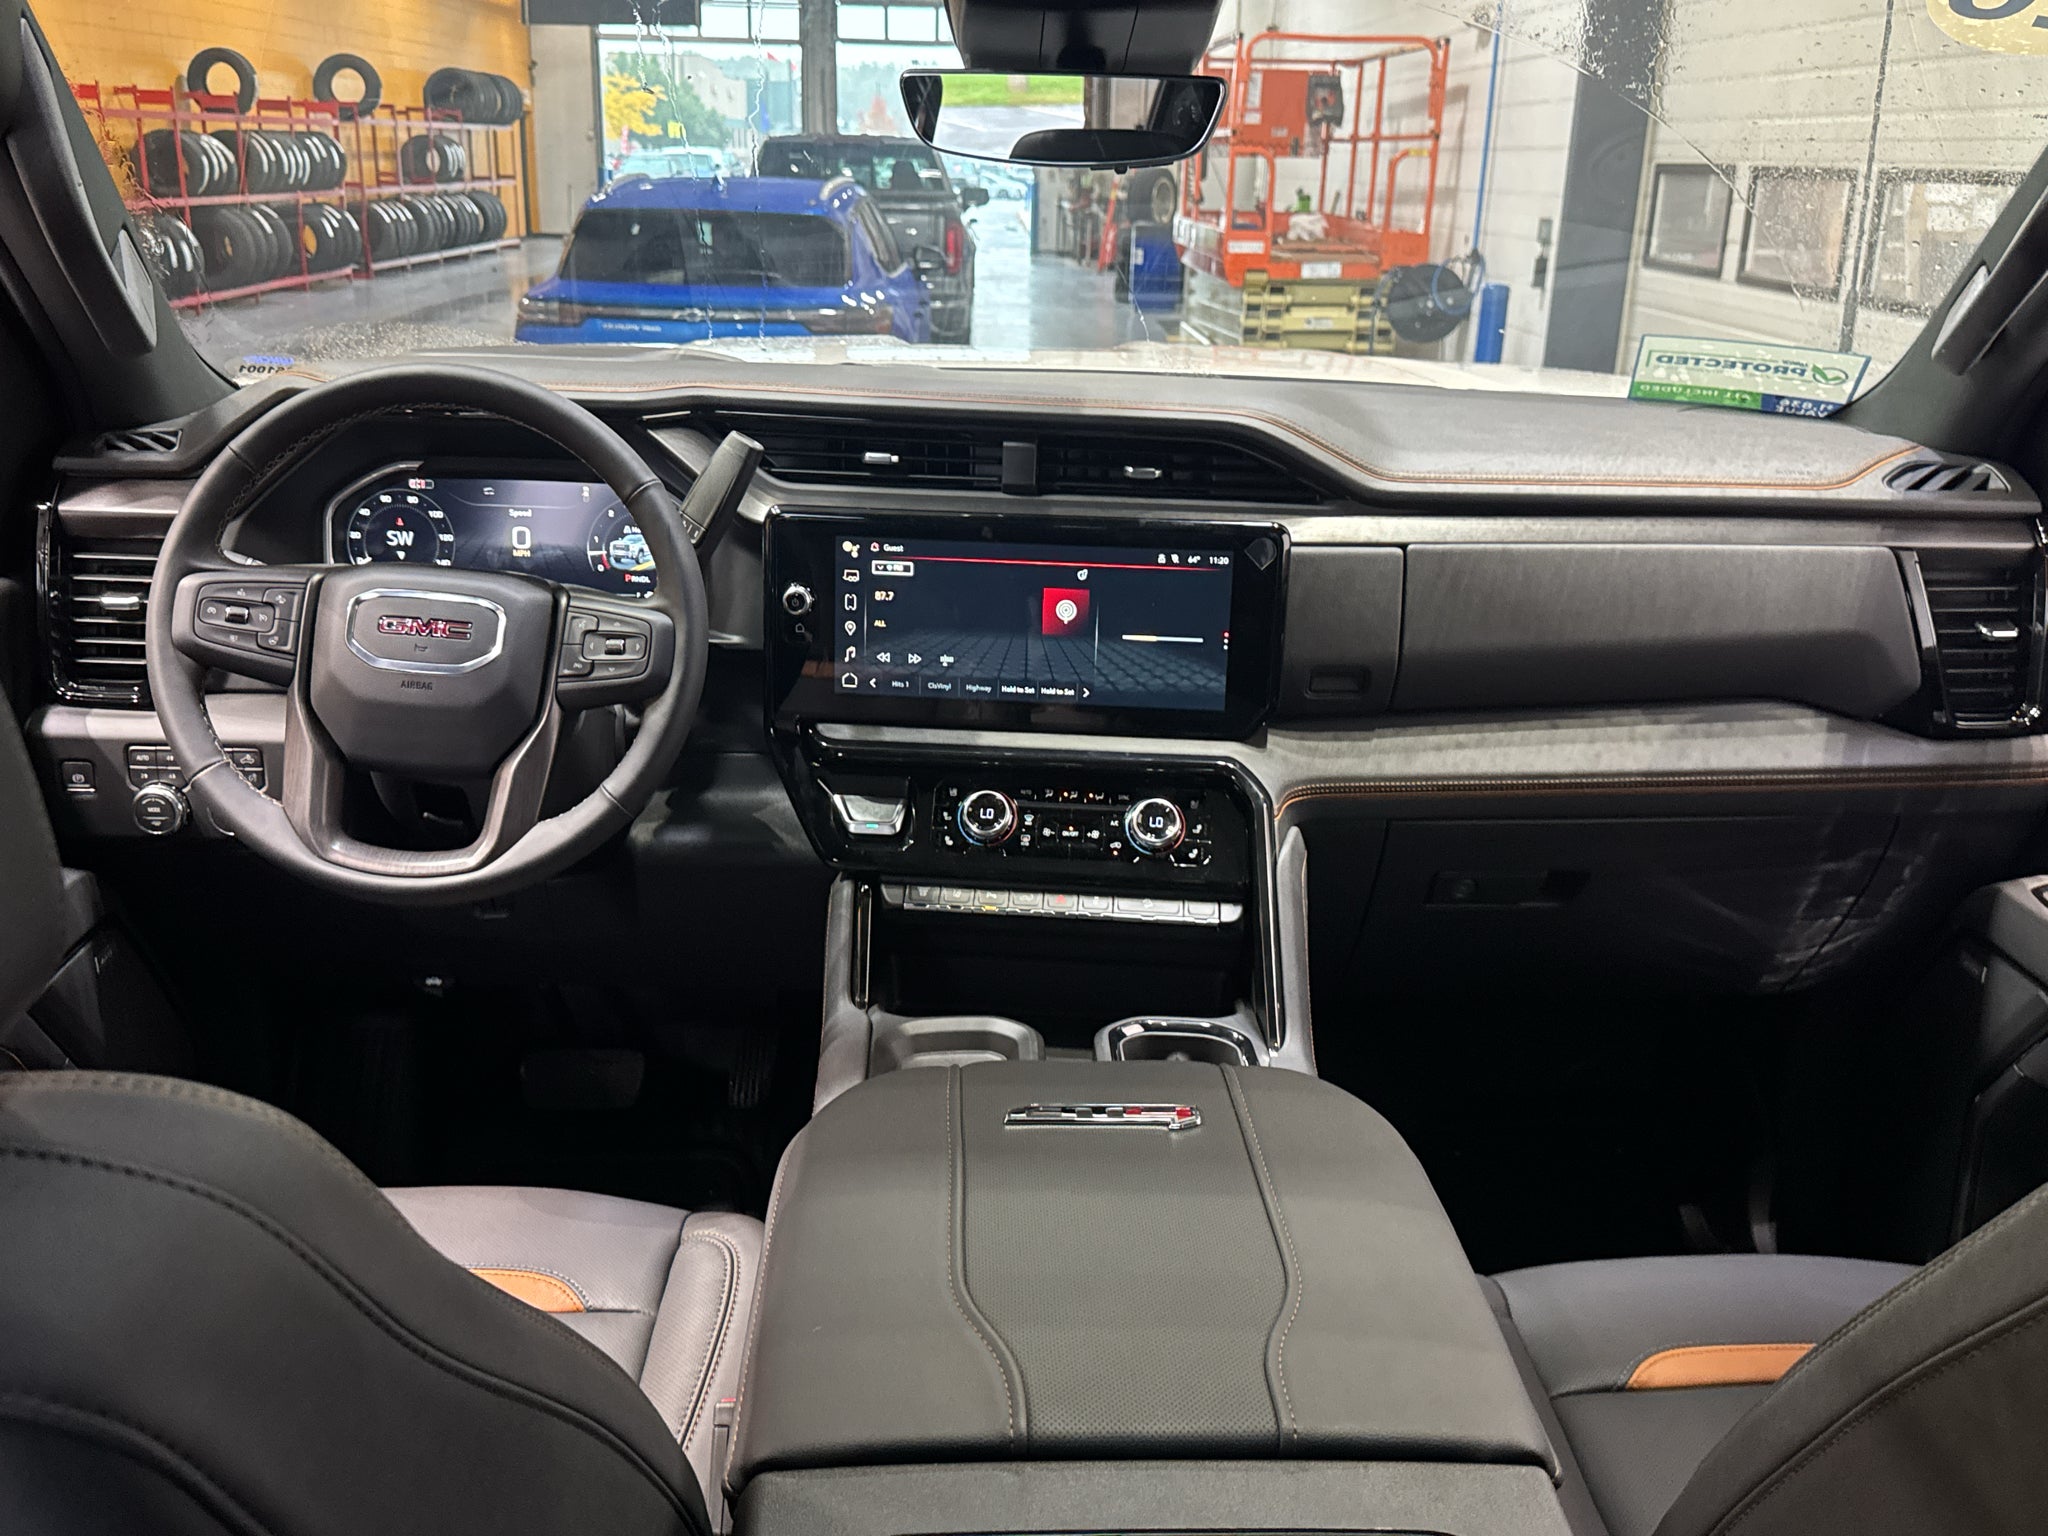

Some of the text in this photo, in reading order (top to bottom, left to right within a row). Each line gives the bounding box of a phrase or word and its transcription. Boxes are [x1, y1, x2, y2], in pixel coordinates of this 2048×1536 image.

[508, 509, 533, 519] Speed
[386, 530, 414, 546] SW
[511, 526, 531, 550] 0
[883, 543, 904, 552] Guest
[512, 549, 531, 558] MPH
[1209, 556, 1229, 565] 11:20
[874, 590, 895, 601] 87.7
[378, 615, 473, 640] GMC
[400, 680, 433, 691] AIRBAG
[891, 680, 904, 688] Hits
[966, 684, 992, 694] Highway
[1001, 685, 1035, 694] Hold to Set
[1041, 687, 1055, 695] Hold
[1064, 688, 1075, 696] Set
[980, 808, 995, 819] LO
[1149, 816, 1164, 828] LO
